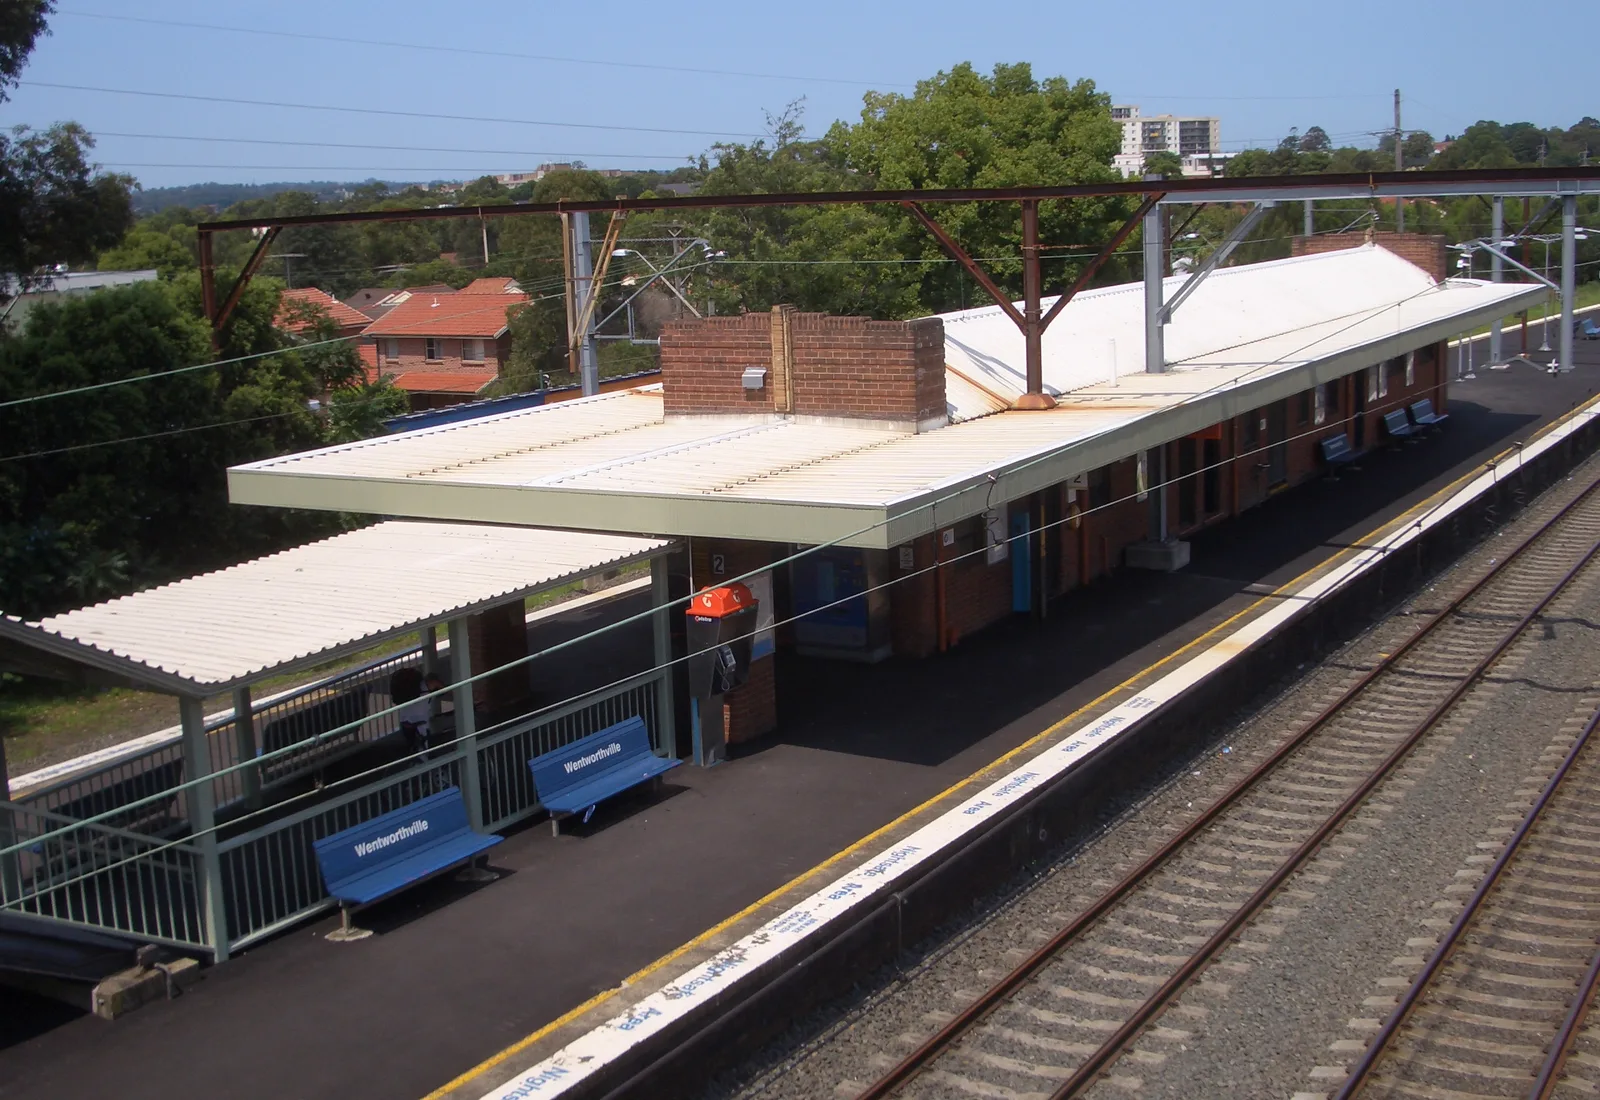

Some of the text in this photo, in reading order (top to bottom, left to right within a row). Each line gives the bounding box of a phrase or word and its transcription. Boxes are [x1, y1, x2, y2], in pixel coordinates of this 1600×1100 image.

[714, 556, 723, 573] 2
[564, 742, 622, 774] Wentworthville
[963, 800, 992, 815] Area
[355, 818, 429, 857] Wentworthville
[828, 845, 921, 901] Nightsafe Area
[617, 1007, 662, 1031] Area
